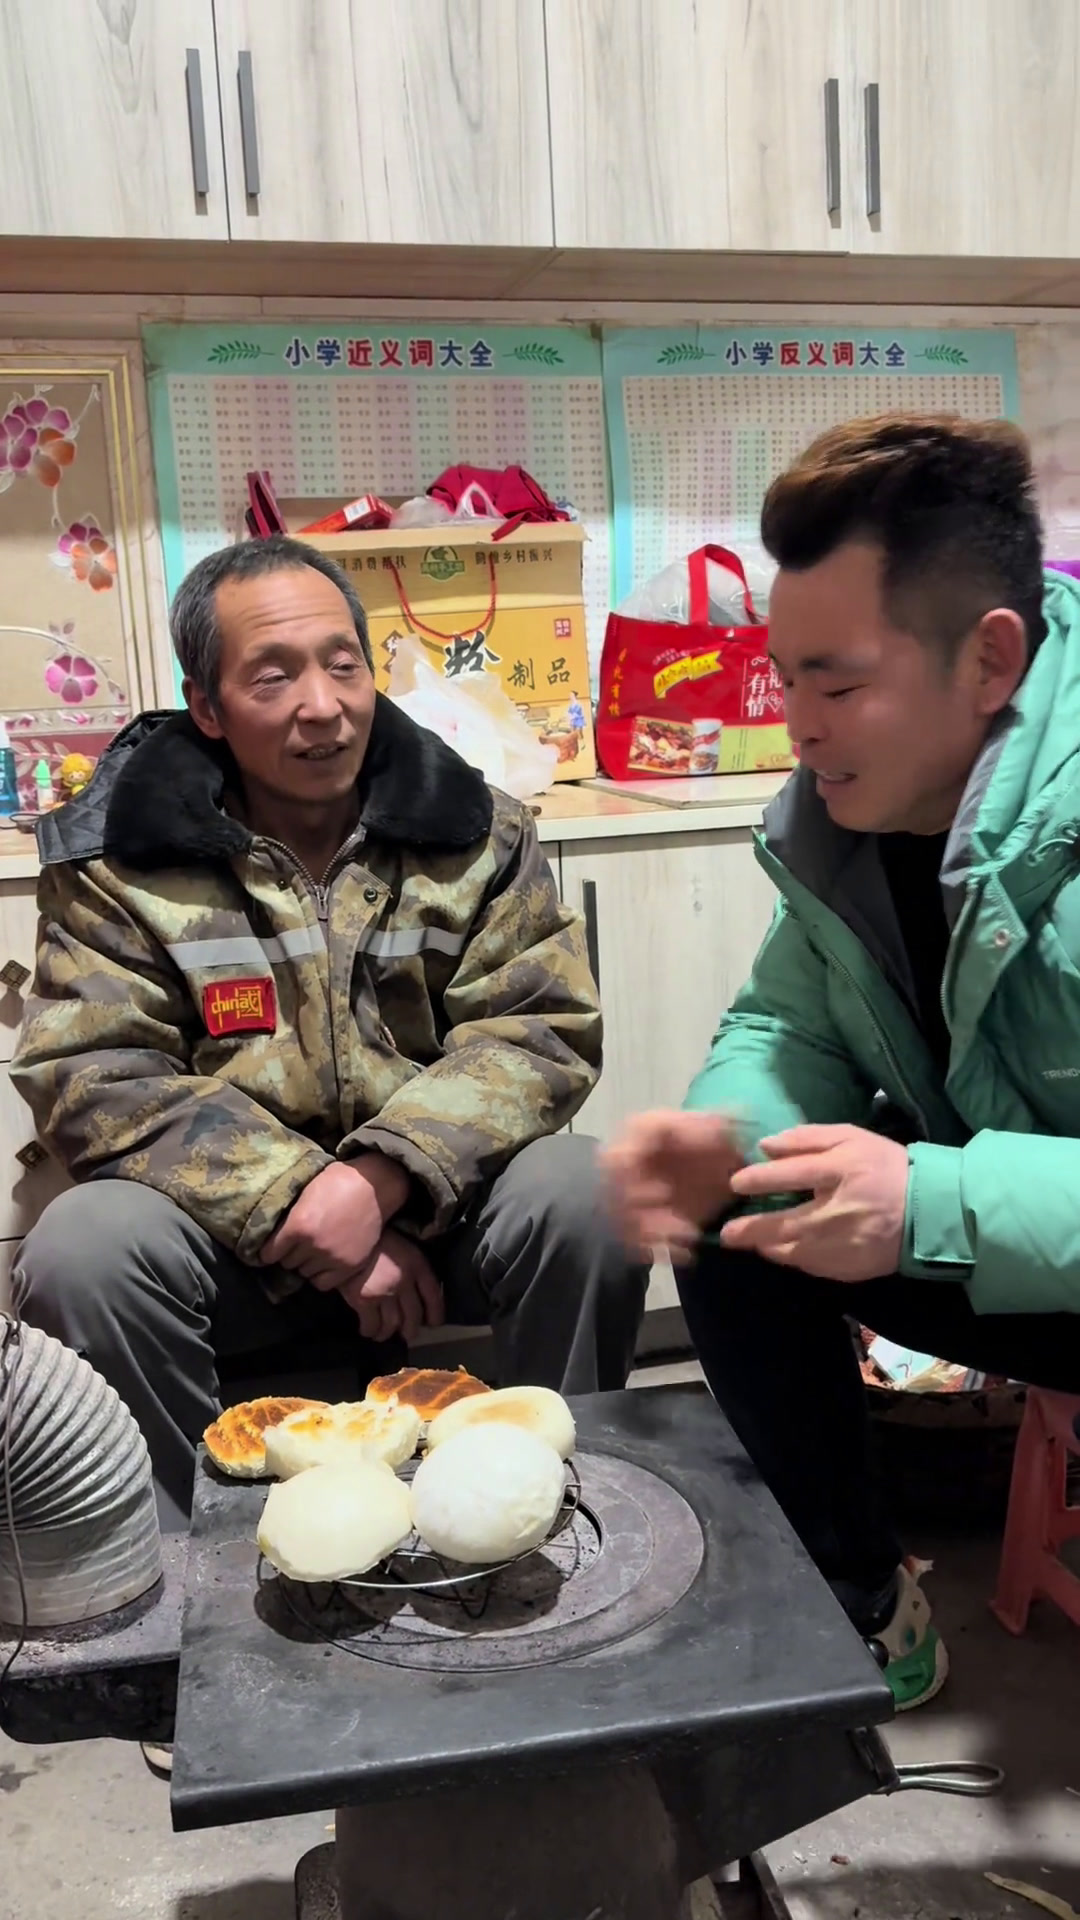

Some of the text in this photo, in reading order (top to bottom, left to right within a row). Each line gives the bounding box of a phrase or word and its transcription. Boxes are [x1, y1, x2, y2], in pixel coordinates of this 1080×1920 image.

[286, 339, 493, 368] 小学近义词大全
[726, 341, 906, 367] 小学反义词大全
[507, 657, 571, 690] 制品
